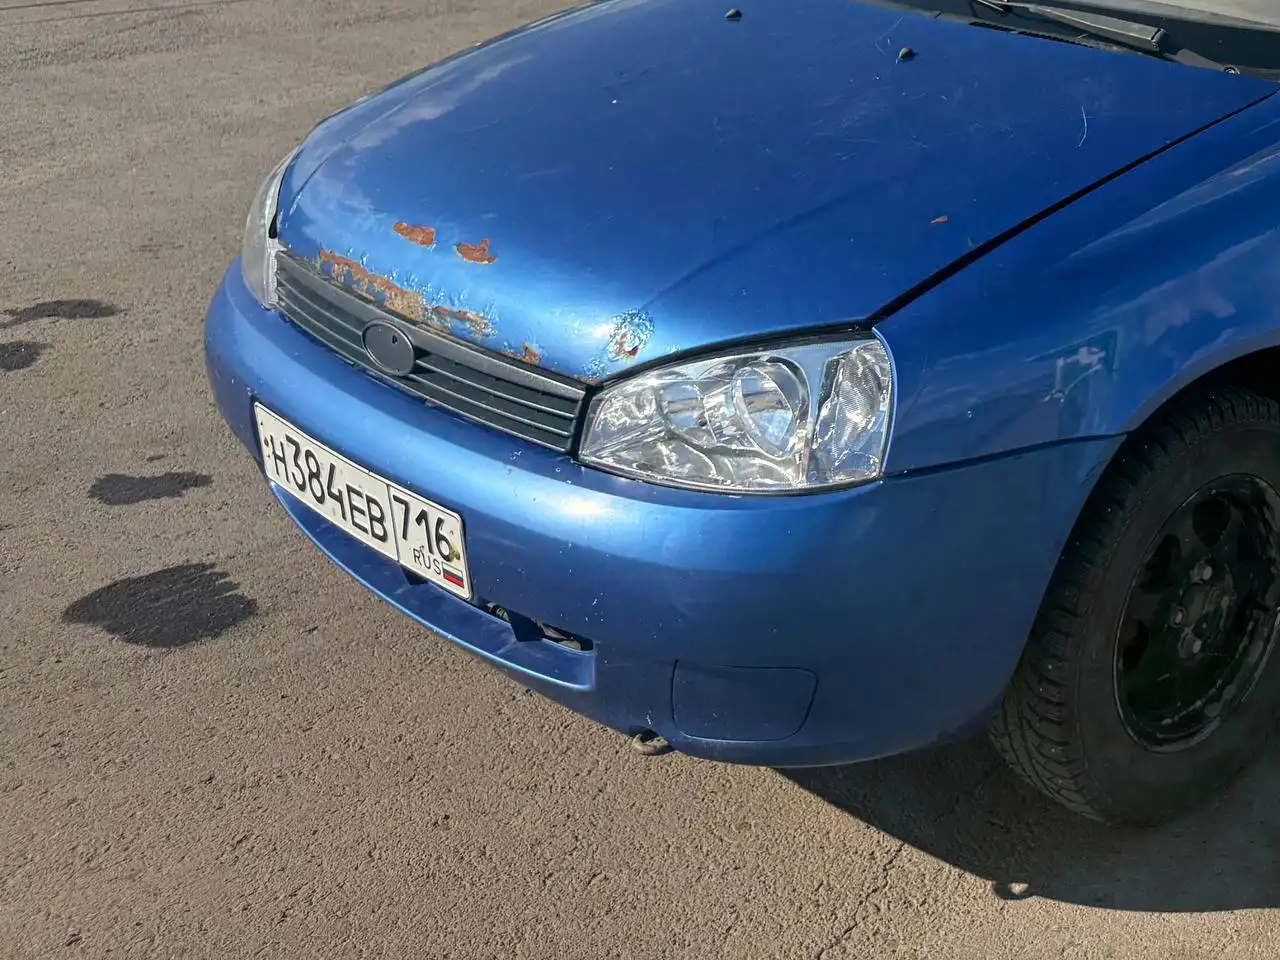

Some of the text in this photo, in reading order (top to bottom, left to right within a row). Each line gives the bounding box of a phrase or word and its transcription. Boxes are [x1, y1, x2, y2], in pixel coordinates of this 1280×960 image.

[269, 433, 454, 562] Н384ЕВ 716
[412, 547, 442, 576] RUS
